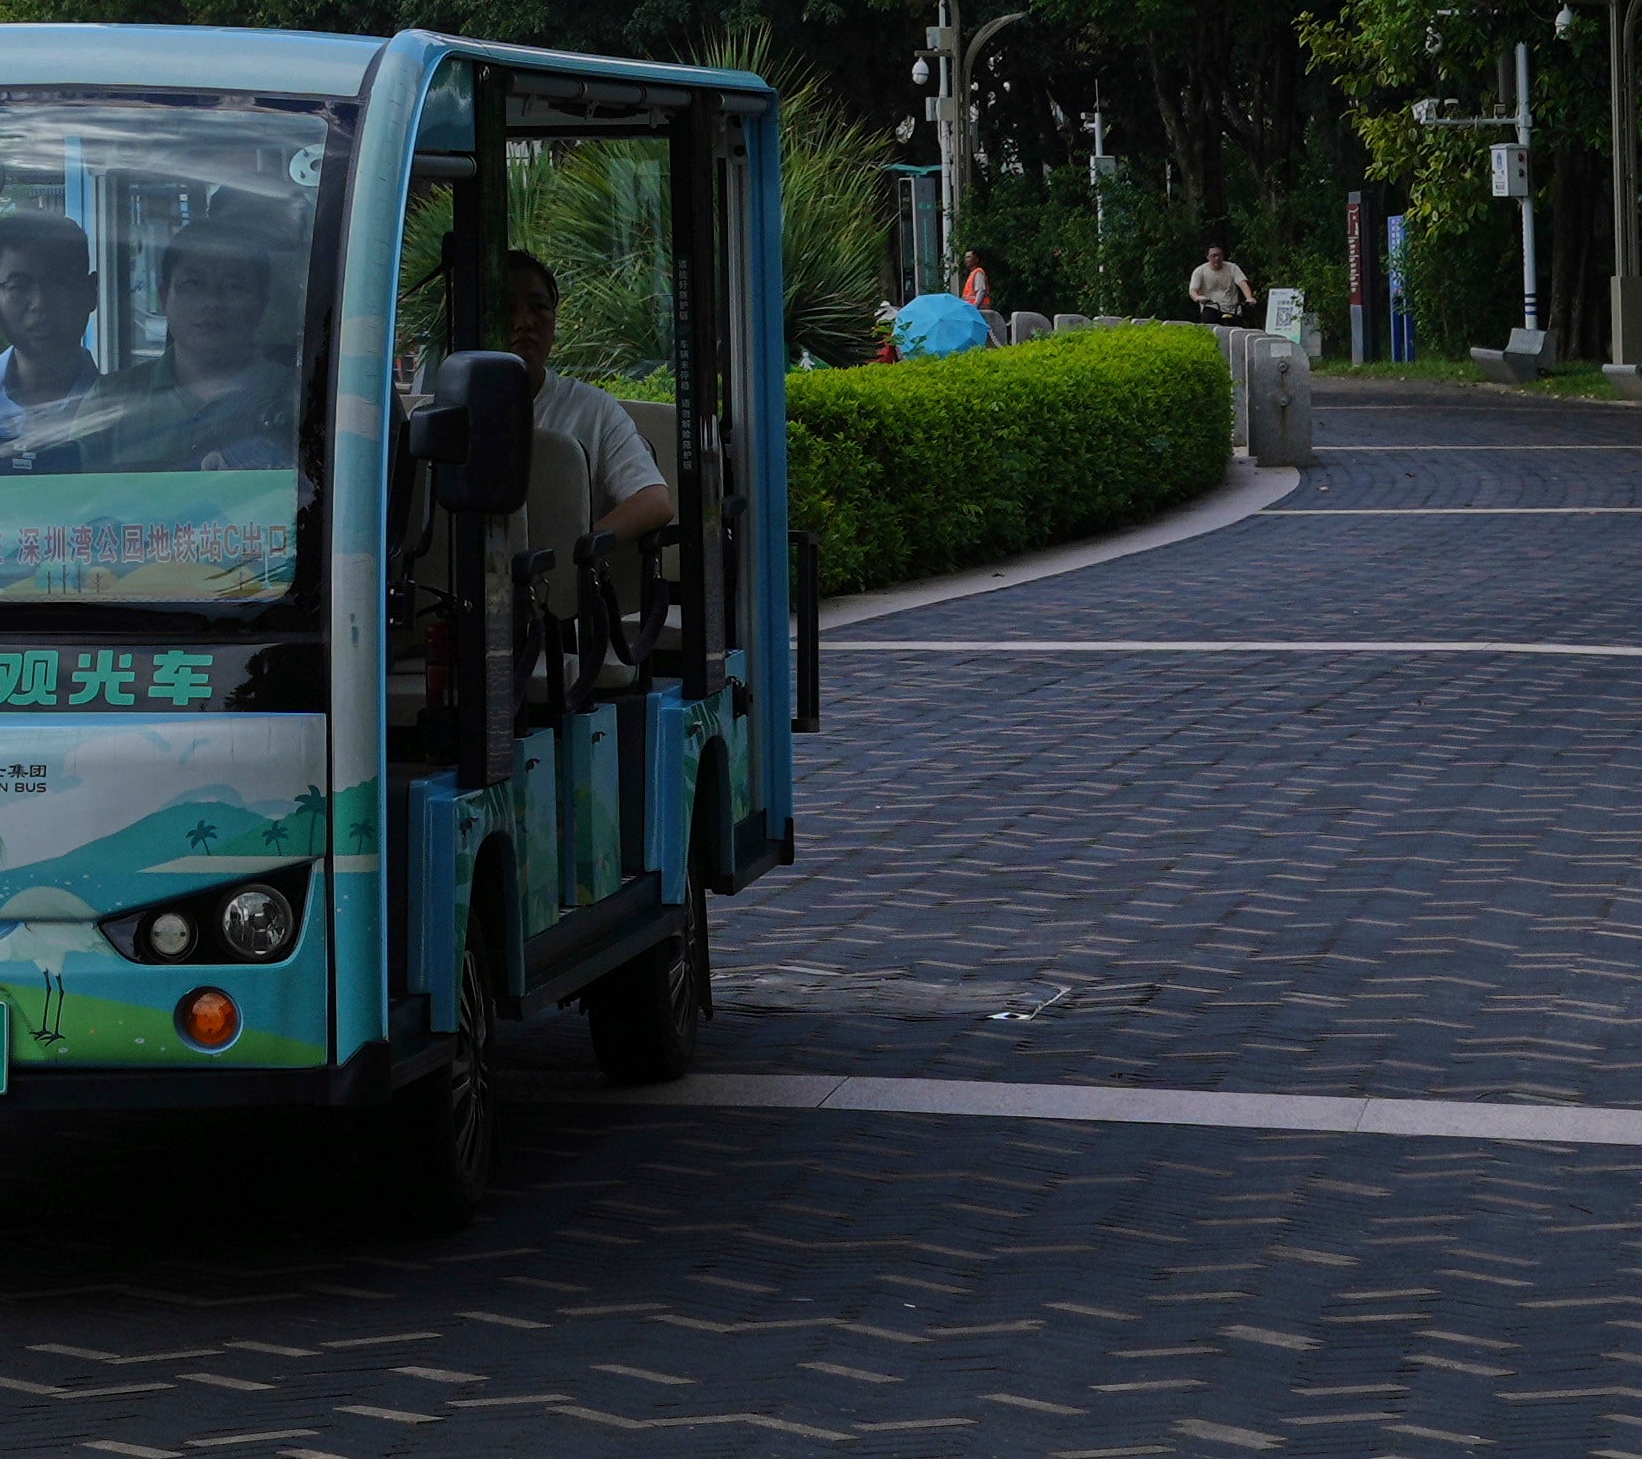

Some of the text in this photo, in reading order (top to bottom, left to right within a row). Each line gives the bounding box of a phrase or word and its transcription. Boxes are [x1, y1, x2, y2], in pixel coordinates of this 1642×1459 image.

[18, 521, 288, 565] 深圳湾公园地铁站C出口
[14, 782, 47, 793] BUS
